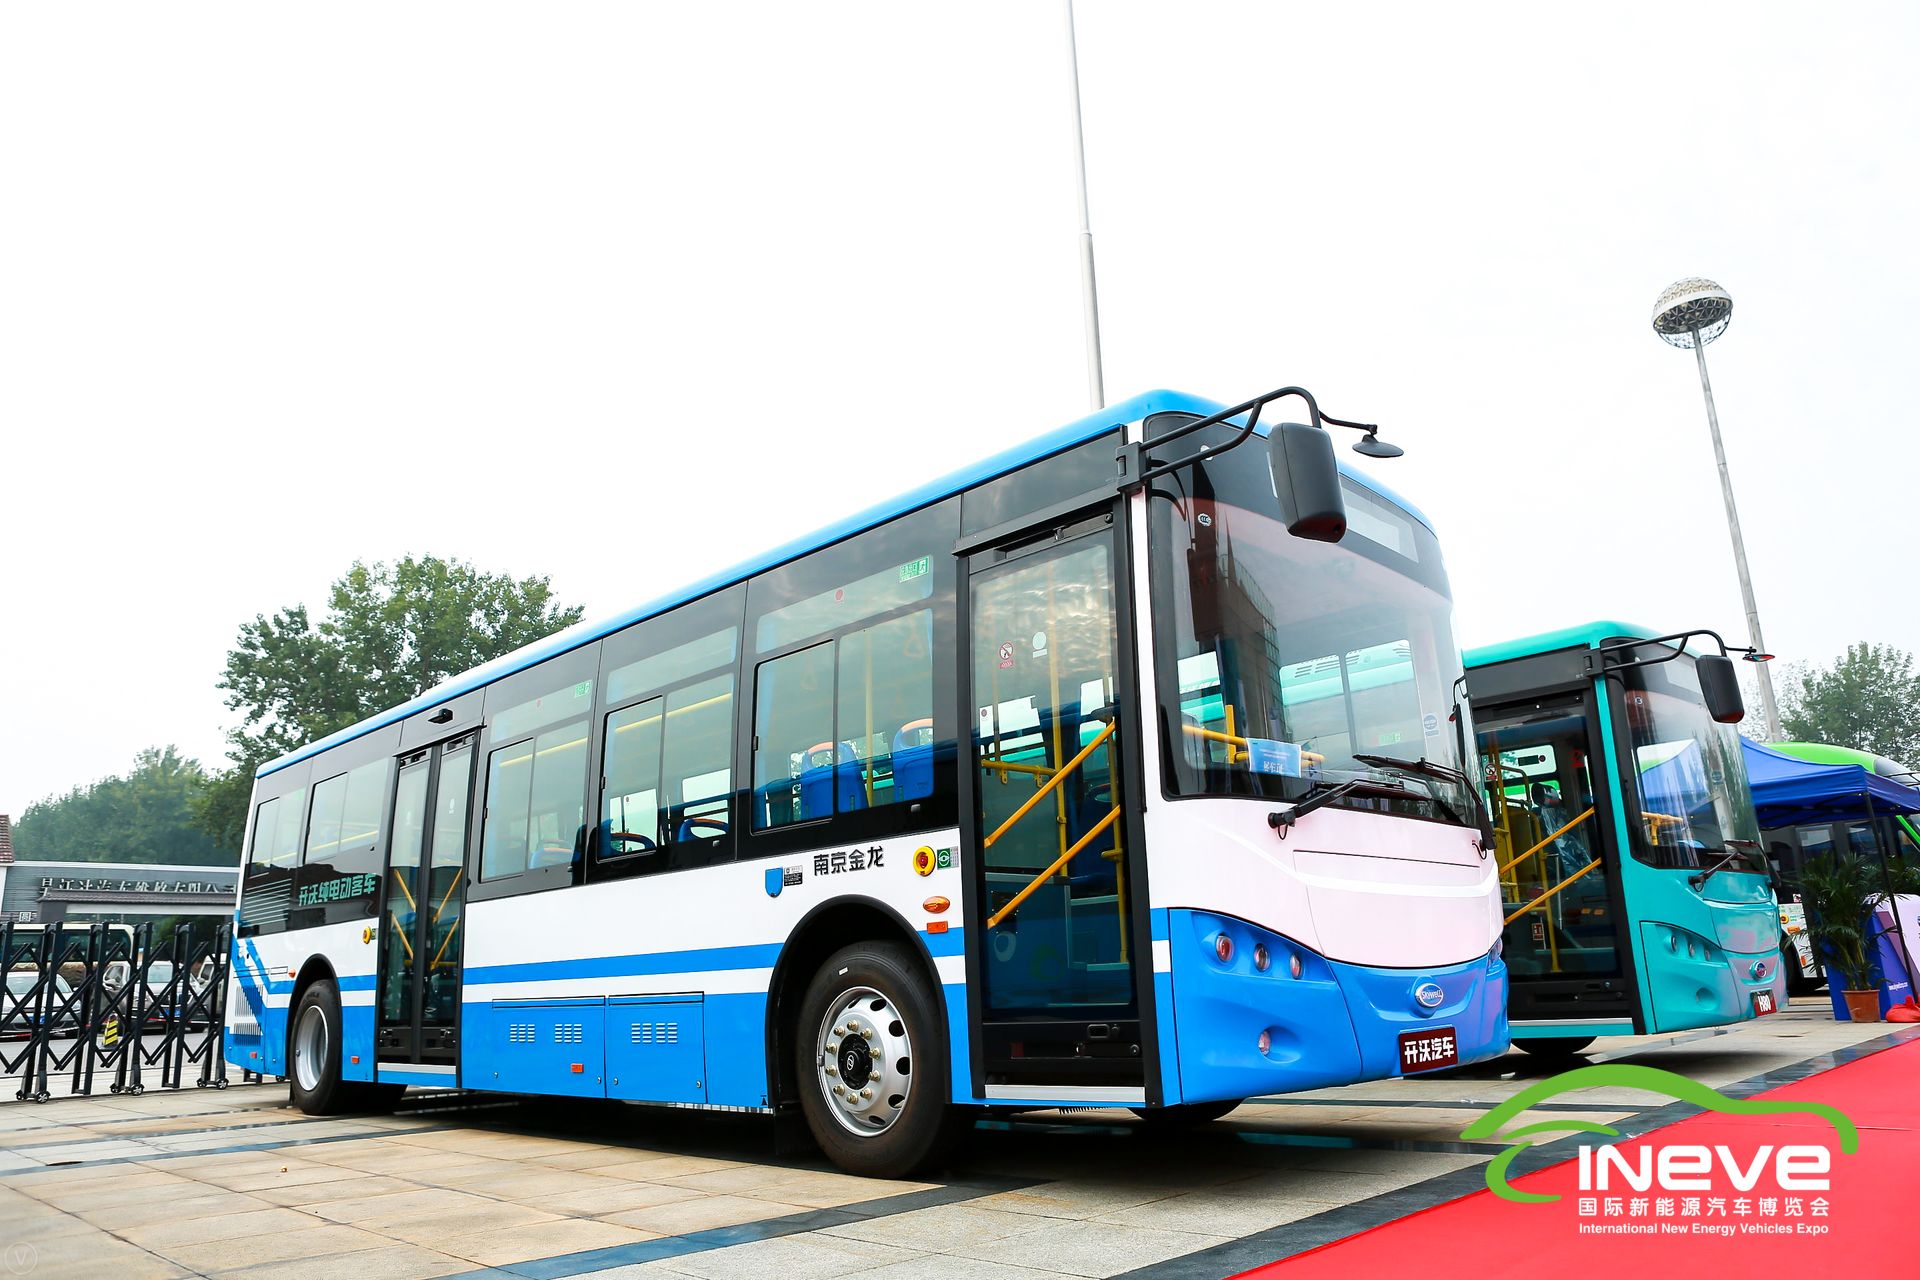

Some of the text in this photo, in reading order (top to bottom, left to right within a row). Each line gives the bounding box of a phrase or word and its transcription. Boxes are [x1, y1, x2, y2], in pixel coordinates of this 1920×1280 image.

[813, 845, 885, 877] 南京金龙
[298, 873, 377, 907] 开沃纯电动客车
[1404, 1036, 1455, 1065] 开沃汽车
